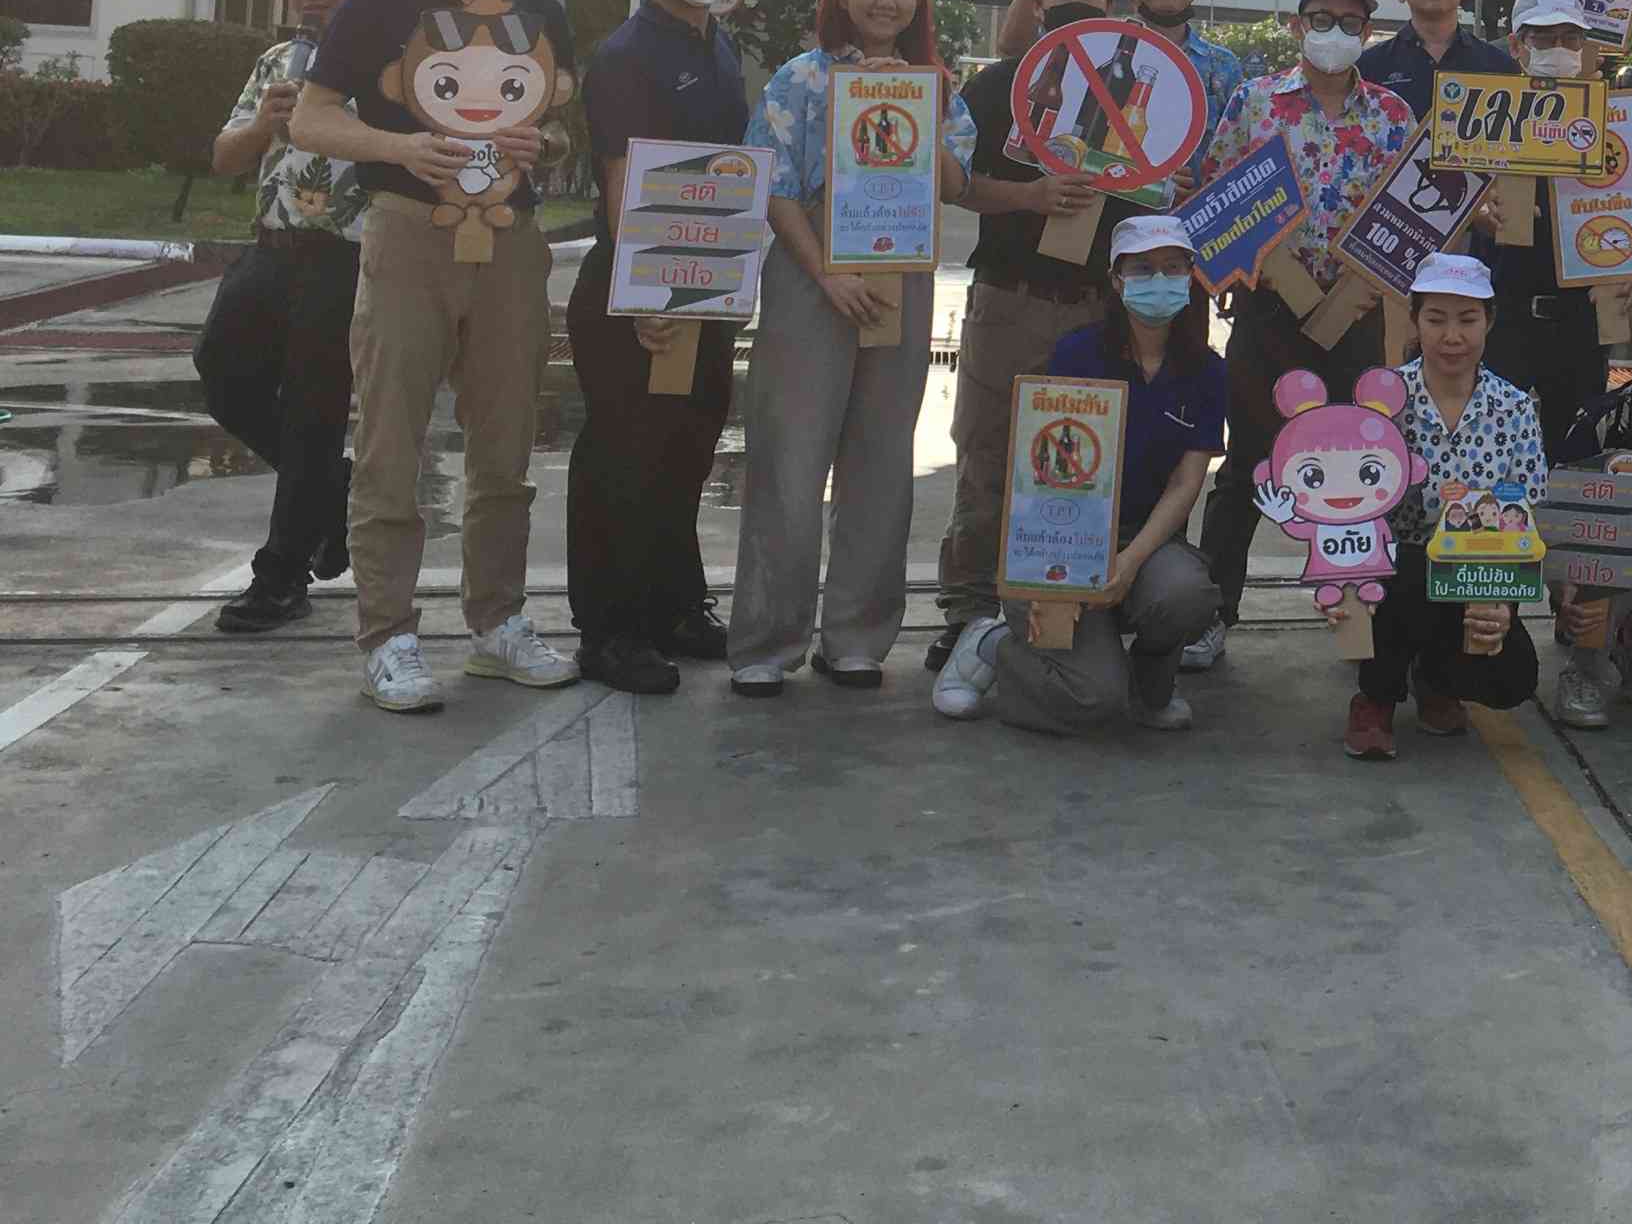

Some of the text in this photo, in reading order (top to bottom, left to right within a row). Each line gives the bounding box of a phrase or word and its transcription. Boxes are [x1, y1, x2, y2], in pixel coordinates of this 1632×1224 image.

[1457, 88, 1566, 143] เมา
[679, 180, 720, 202] สติ
[666, 221, 720, 244] วินัย
[1366, 222, 1400, 254] 100
[1401, 247, 1420, 271] %
[660, 256, 713, 287] น้ำใจ
[1581, 479, 1617, 500] สติ
[1322, 529, 1371, 555] อภัย
[1571, 520, 1617, 542] วินัย
[1456, 564, 1515, 584] ดื่มไม่ขับ
[1434, 580, 1536, 597] ไป-กลับปลอดภัย
